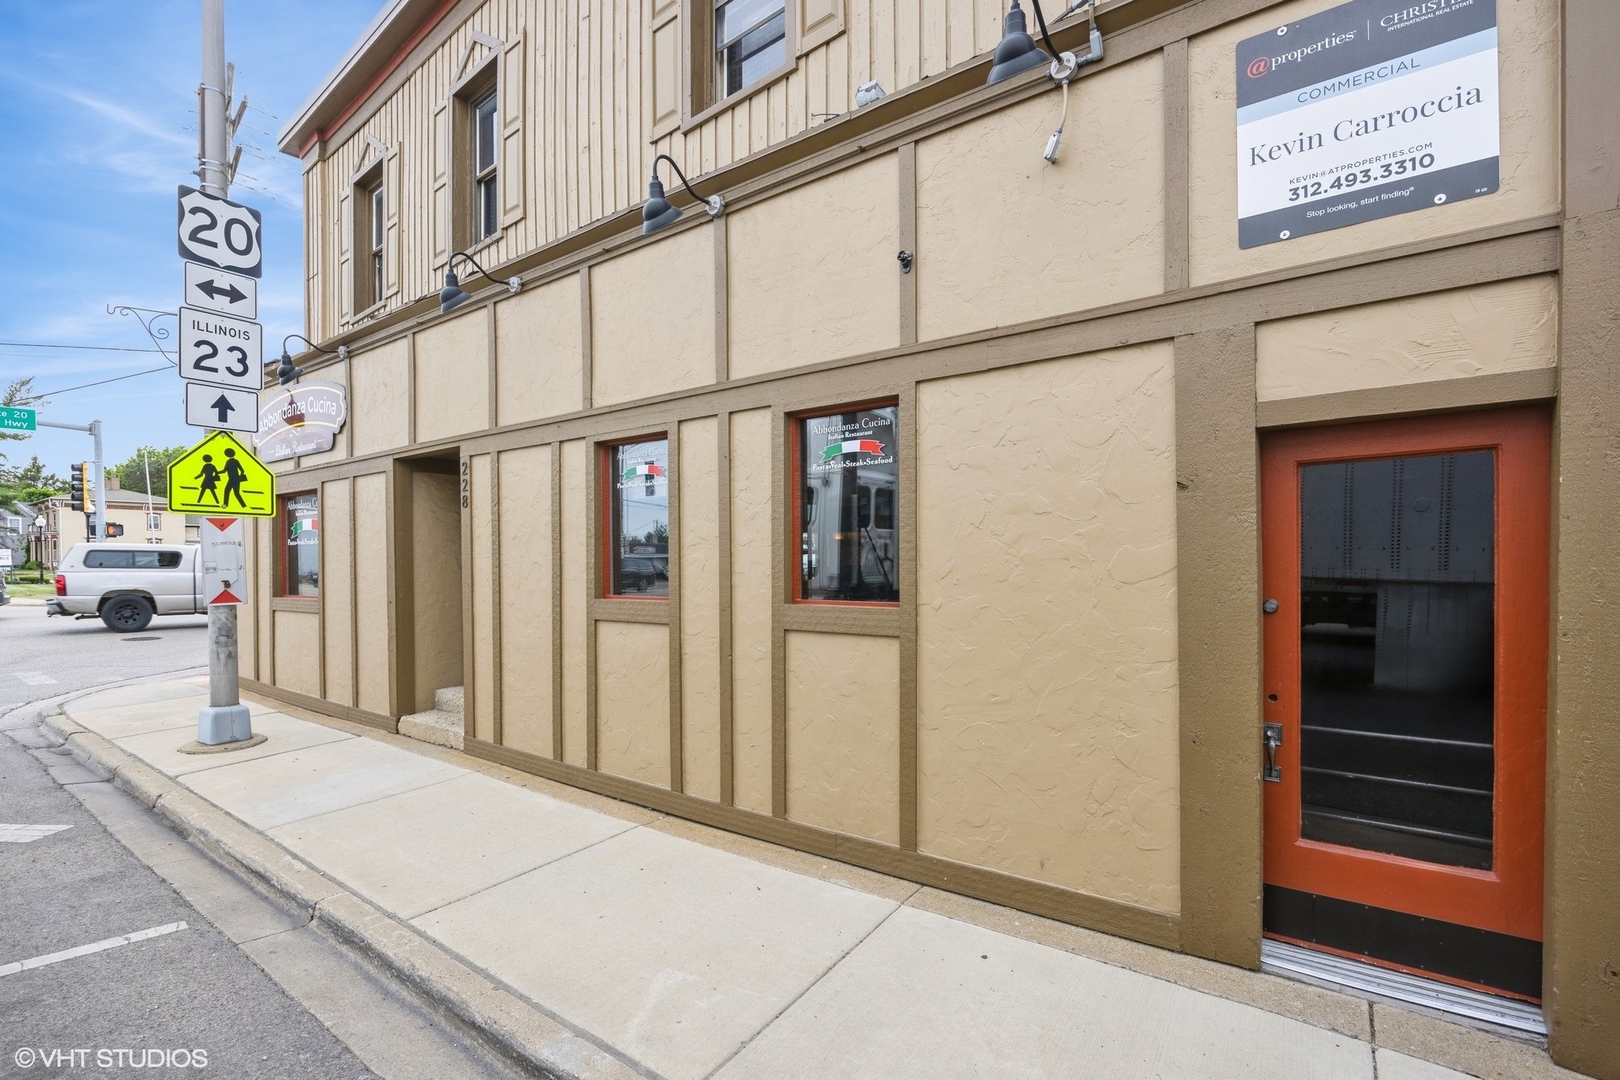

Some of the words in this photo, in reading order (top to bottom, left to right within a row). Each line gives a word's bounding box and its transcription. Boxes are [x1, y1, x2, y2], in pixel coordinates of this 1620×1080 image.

[1380, 0, 1462, 27] CHRIST
[1387, 13, 1434, 32] INTERNATIONAL
[1435, 7, 1451, 17] REAL
[1452, 0, 1473, 11] ESTATE
[1297, 58, 1421, 104] COMMERCIAL
[1250, 131, 1324, 167] Kevin
[1333, 85, 1483, 142] Carroccia
[1288, 152, 1435, 202] 312.493.3310
[1289, 142, 1433, 185] KEVIN@ATPROPERTIES.COM
[1306, 209, 1325, 218] Stop
[1360, 195, 1379, 206] start
[188, 206, 254, 257] 20
[192, 319, 251, 341] ILLINOIS
[193, 339, 249, 377] 23
[4, 418, 28, 429] Hwy
[13, 410, 28, 419] 20
[259, 401, 306, 435] Abbondanza
[307, 395, 337, 415] Cucina
[812, 421, 859, 435] Abbondanza
[861, 417, 891, 429] Cucina
[845, 430, 873, 438] Restaurant
[461, 461, 469, 509] 228
